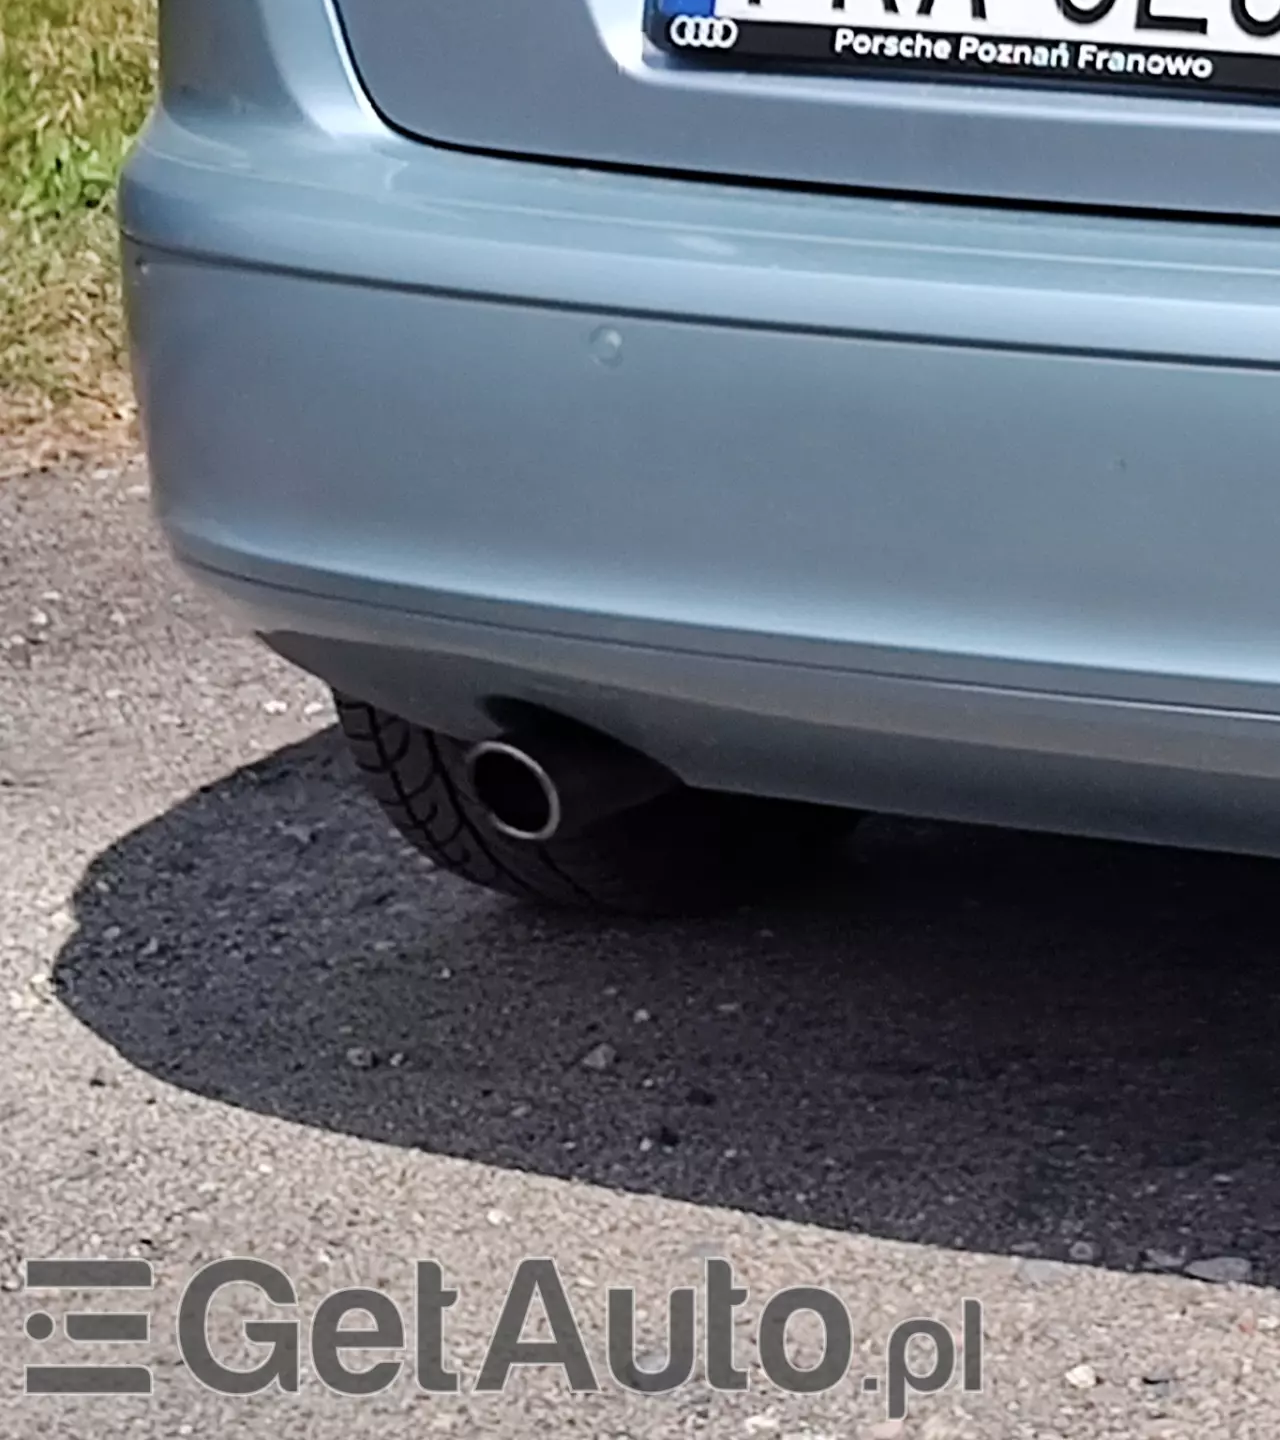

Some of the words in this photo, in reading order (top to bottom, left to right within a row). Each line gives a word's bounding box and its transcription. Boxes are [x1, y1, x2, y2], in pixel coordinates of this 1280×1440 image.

[834, 28, 952, 60] Porsche
[958, 35, 1069, 69] Poznań
[1077, 43, 1214, 79] Franowo
